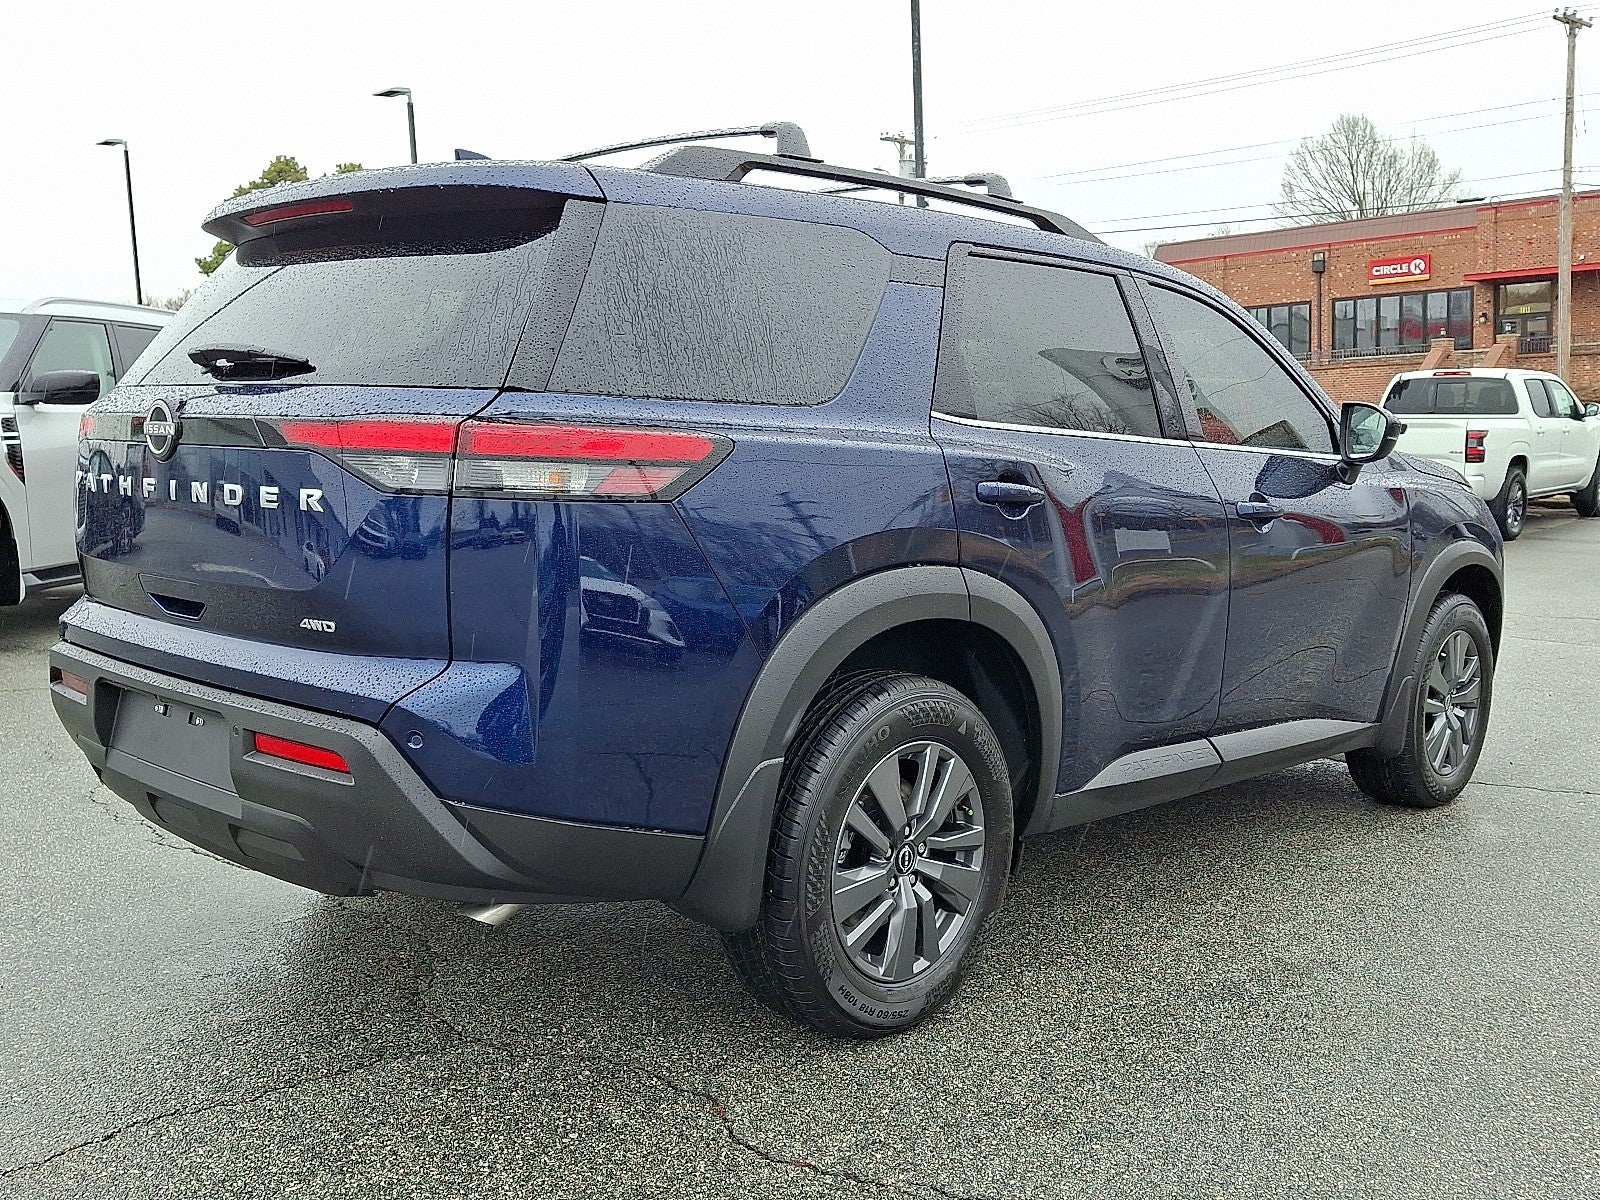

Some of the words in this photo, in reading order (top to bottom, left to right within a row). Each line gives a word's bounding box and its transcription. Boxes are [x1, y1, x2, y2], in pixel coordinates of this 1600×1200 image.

[1372, 263, 1409, 276] CIRCLE
[1409, 258, 1425, 274] K
[76, 470, 324, 513] PATHFINDER
[299, 618, 336, 633] 4WD
[837, 985, 858, 1006] 108H
[858, 1003, 877, 1017] R18
[876, 1009, 910, 1019] 255/60
